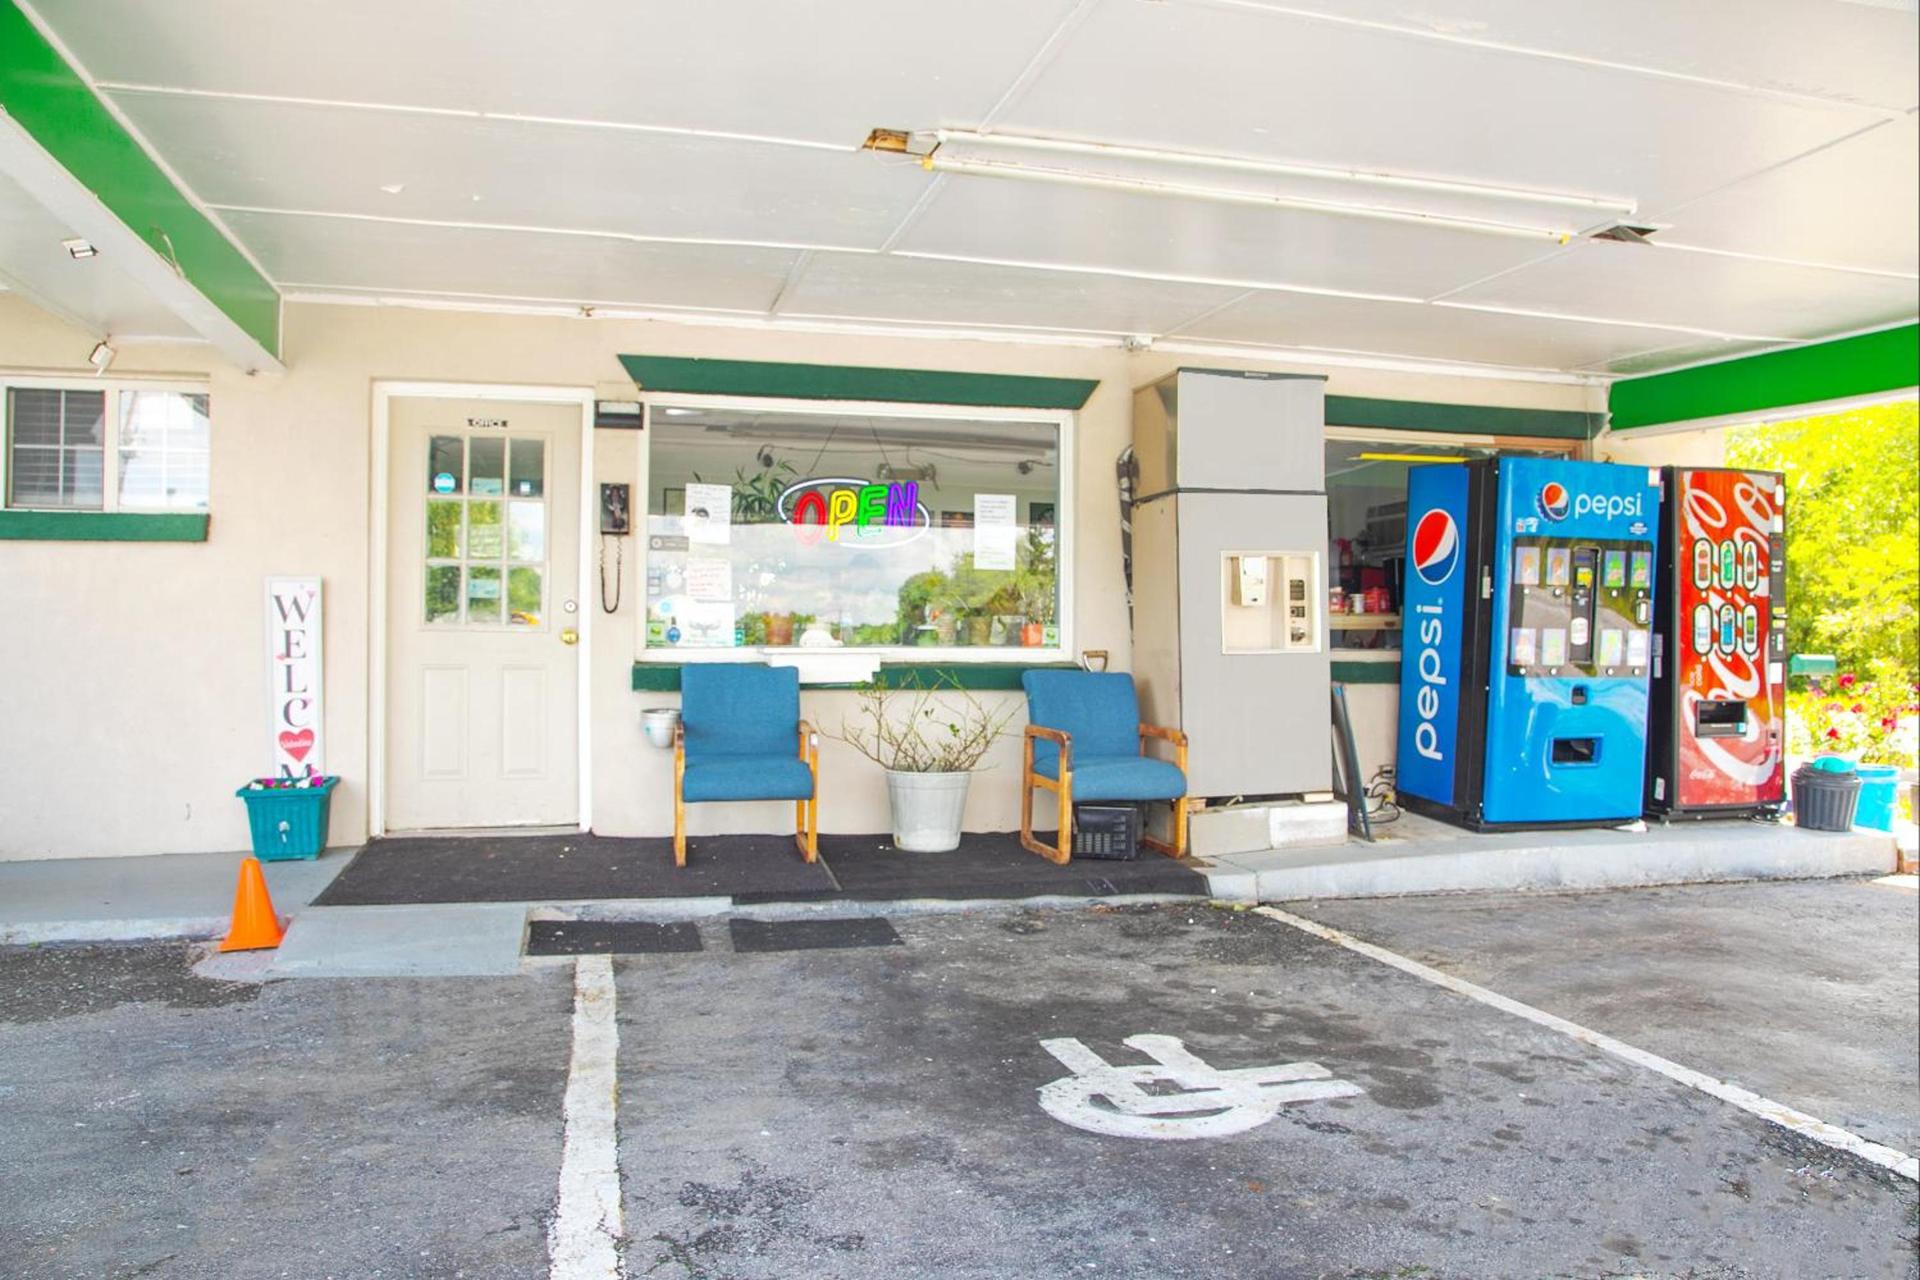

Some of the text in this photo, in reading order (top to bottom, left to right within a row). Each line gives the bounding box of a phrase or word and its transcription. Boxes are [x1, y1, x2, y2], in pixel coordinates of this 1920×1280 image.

[792, 480, 919, 547] OPEN
[1574, 492, 1643, 521] pepsi
[1415, 603, 1447, 761] pepsi
